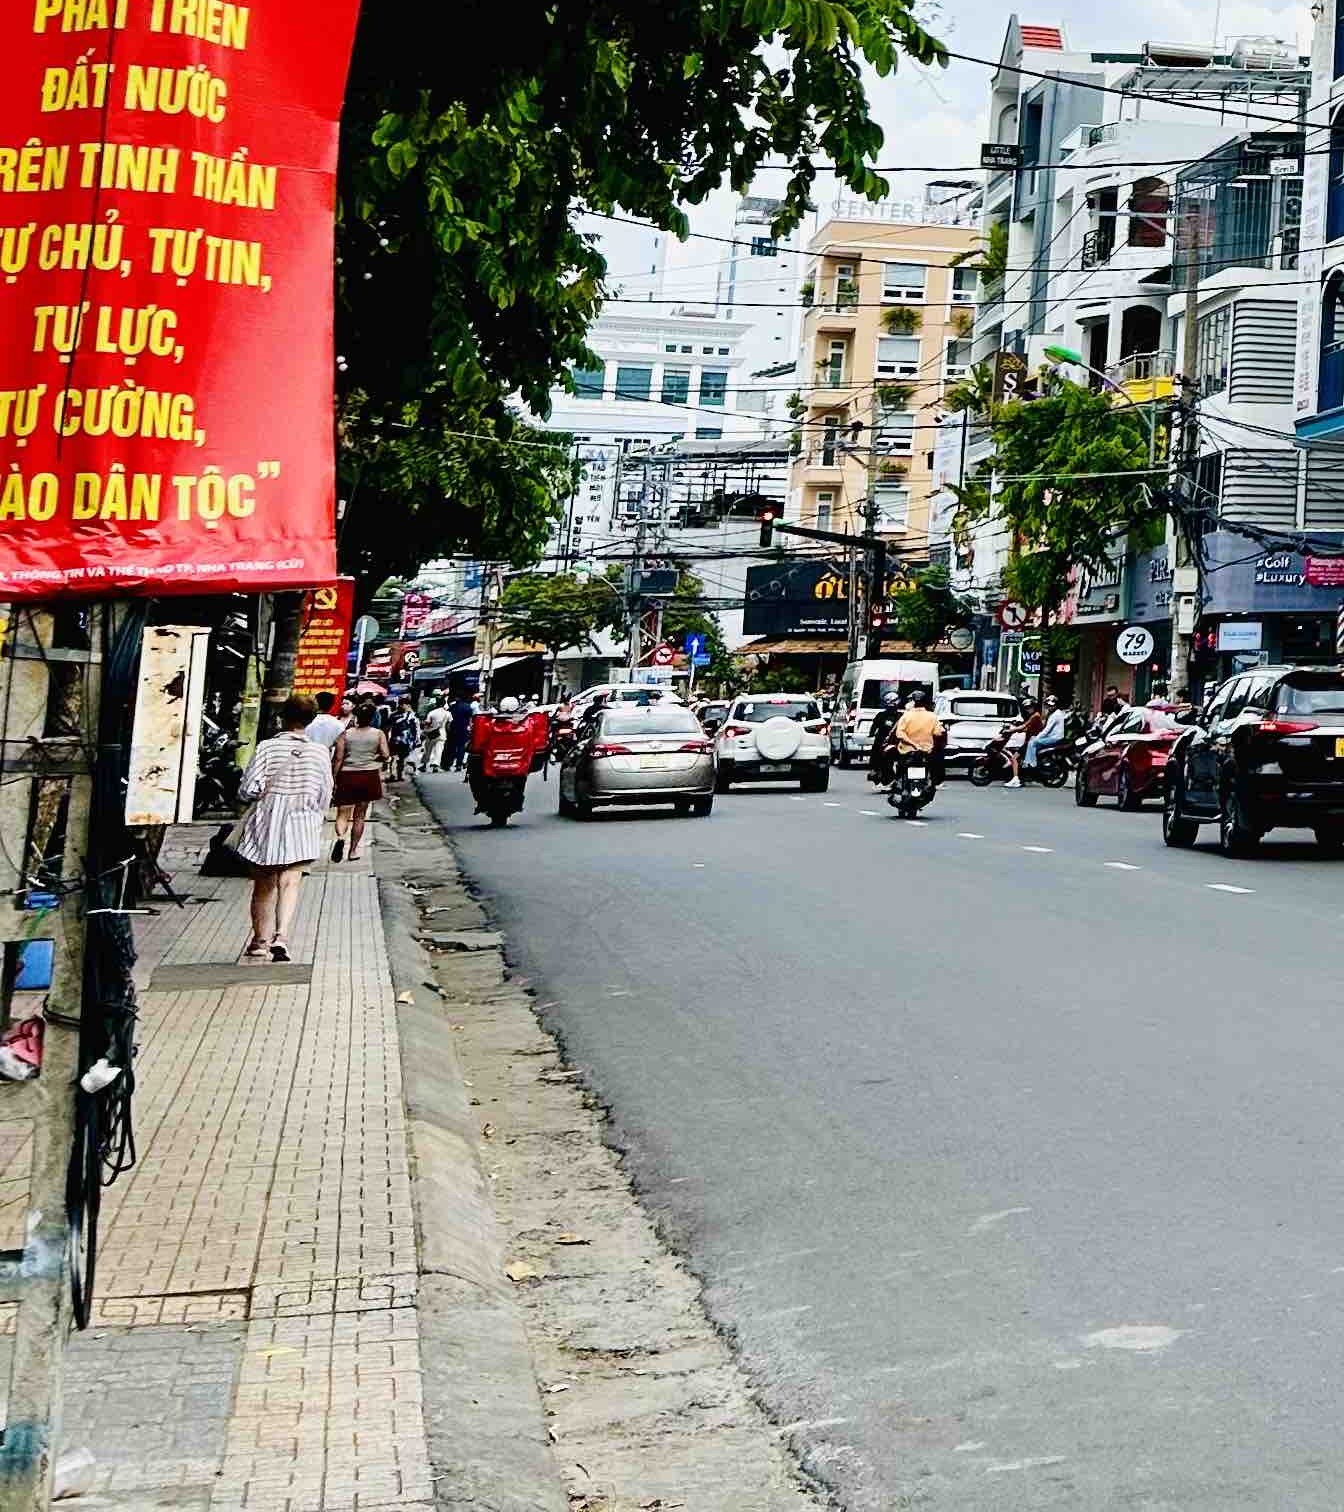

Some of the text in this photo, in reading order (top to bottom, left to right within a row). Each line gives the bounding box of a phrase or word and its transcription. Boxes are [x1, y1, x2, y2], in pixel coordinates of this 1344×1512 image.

[41, 47, 227, 124] ĐẤT NƯỚC
[79, 143, 181, 194] TINH
[191, 147, 277, 210] THẦN
[38, 208, 132, 278] CHỦ,
[149, 227, 204, 286] TỰ
[205, 234, 272, 293] TIN,
[33, 301, 185, 365] TỰ LỰC,
[54, 379, 206, 448] CƯỜNG,
[71, 463, 161, 521] DÂN
[1255, 572, 1306, 586] #Luxury
[1256, 556, 1290, 569] #Golf
[1124, 633, 1146, 650] 79
